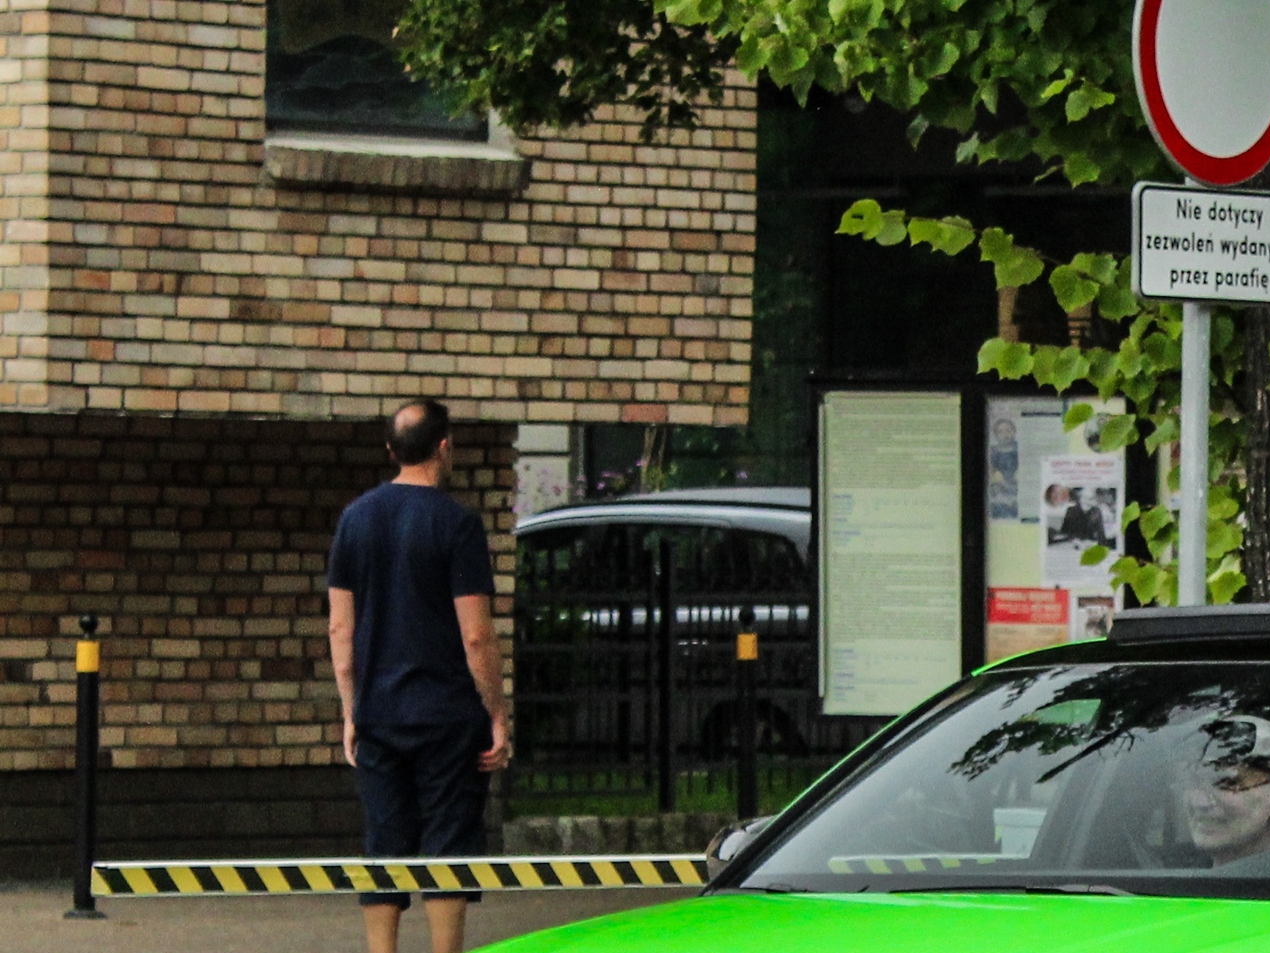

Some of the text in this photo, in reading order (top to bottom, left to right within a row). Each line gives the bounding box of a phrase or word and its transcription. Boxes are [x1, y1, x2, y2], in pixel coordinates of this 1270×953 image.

[1176, 199, 1263, 230] Nie dotyczy
[1146, 232, 1214, 254] zezwoleń
[1170, 268, 1269, 294] przez parafię
